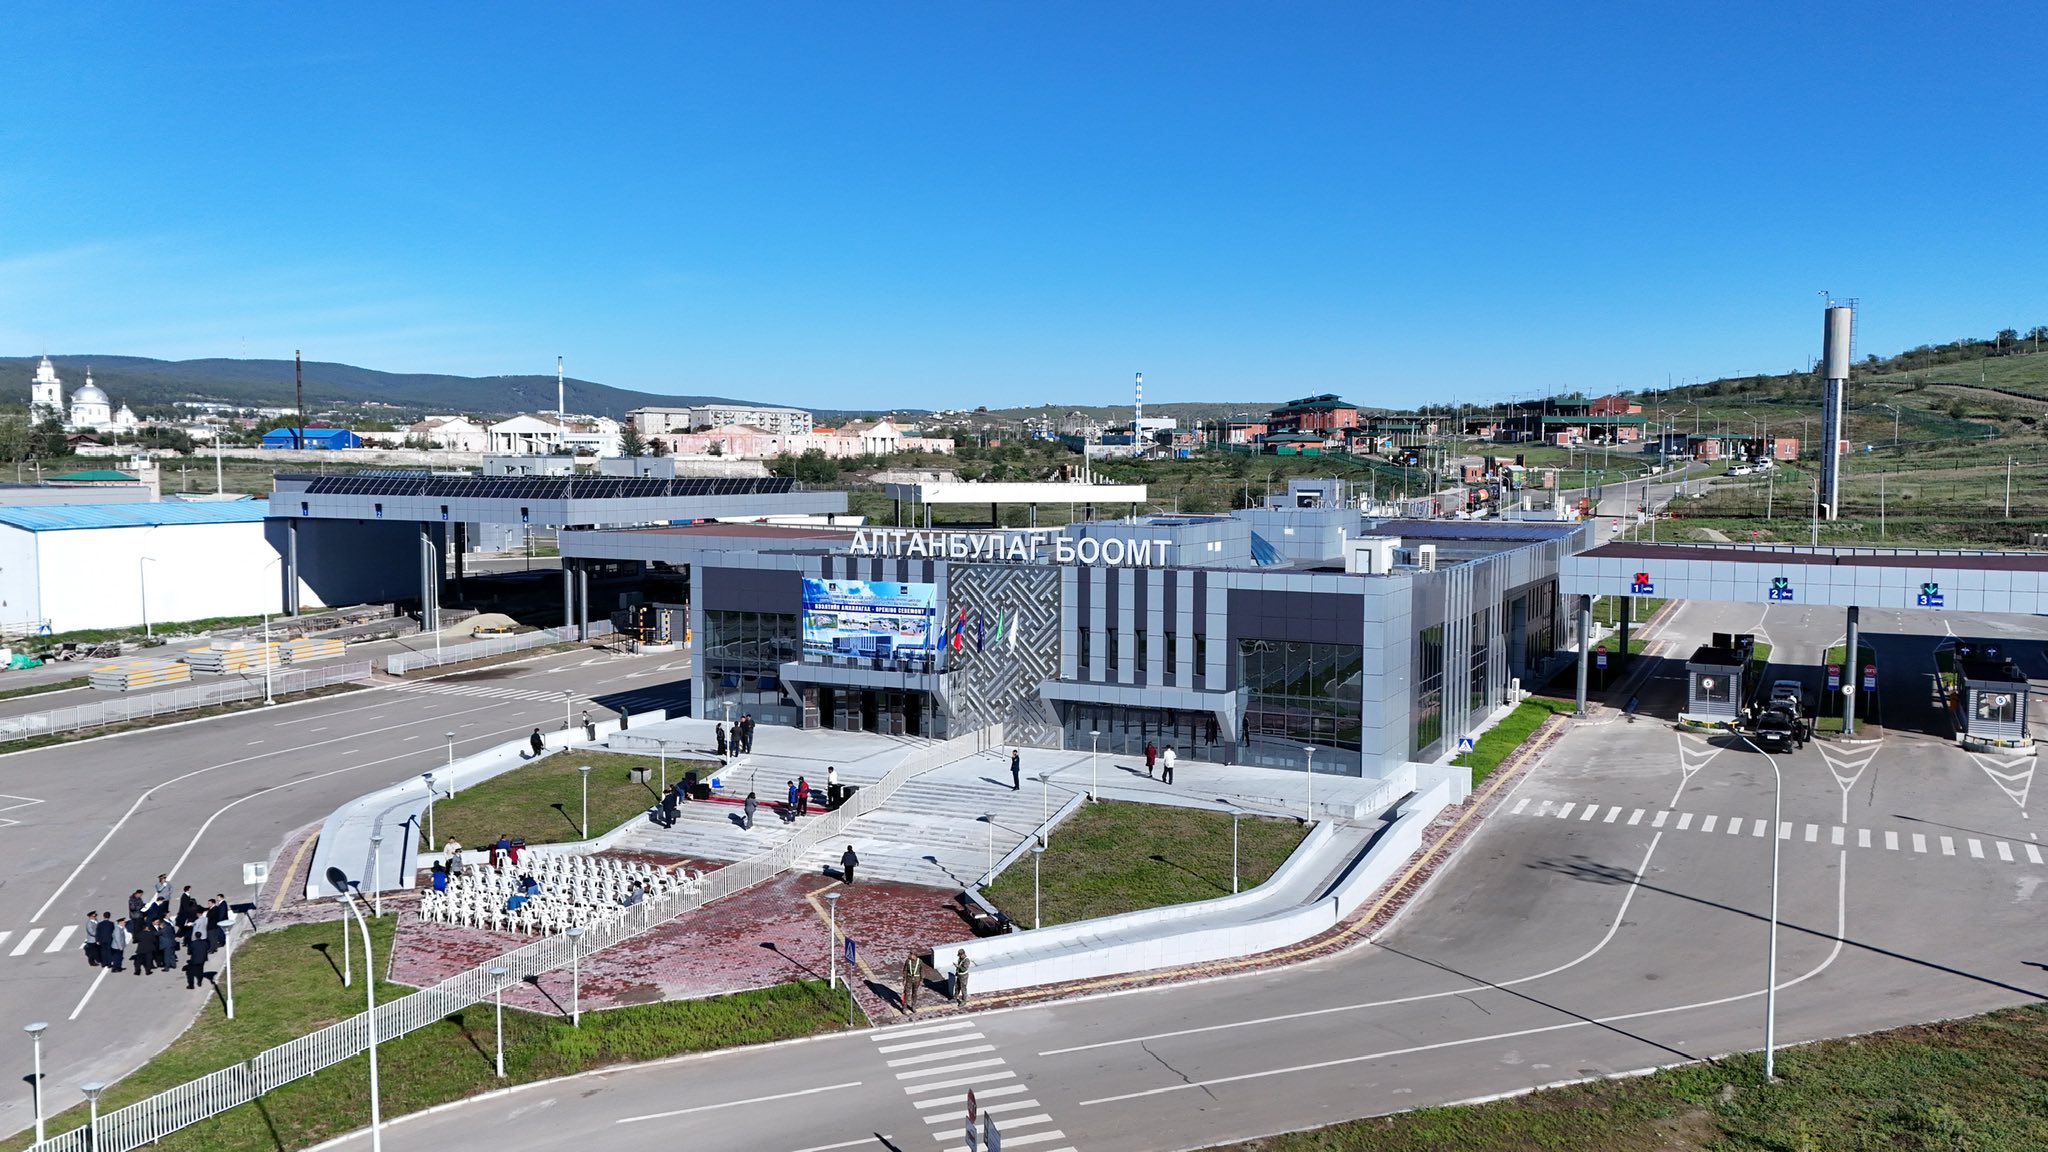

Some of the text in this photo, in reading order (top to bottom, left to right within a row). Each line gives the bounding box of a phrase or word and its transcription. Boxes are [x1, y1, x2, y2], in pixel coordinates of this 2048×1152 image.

[850, 530, 1172, 566] АЛТАНБУЛАГ БООМТ
[1633, 584, 1639, 592] 1
[1771, 589, 1778, 599] 2
[1920, 595, 1927, 605] 3
[898, 607, 925, 615] CEREMONY
